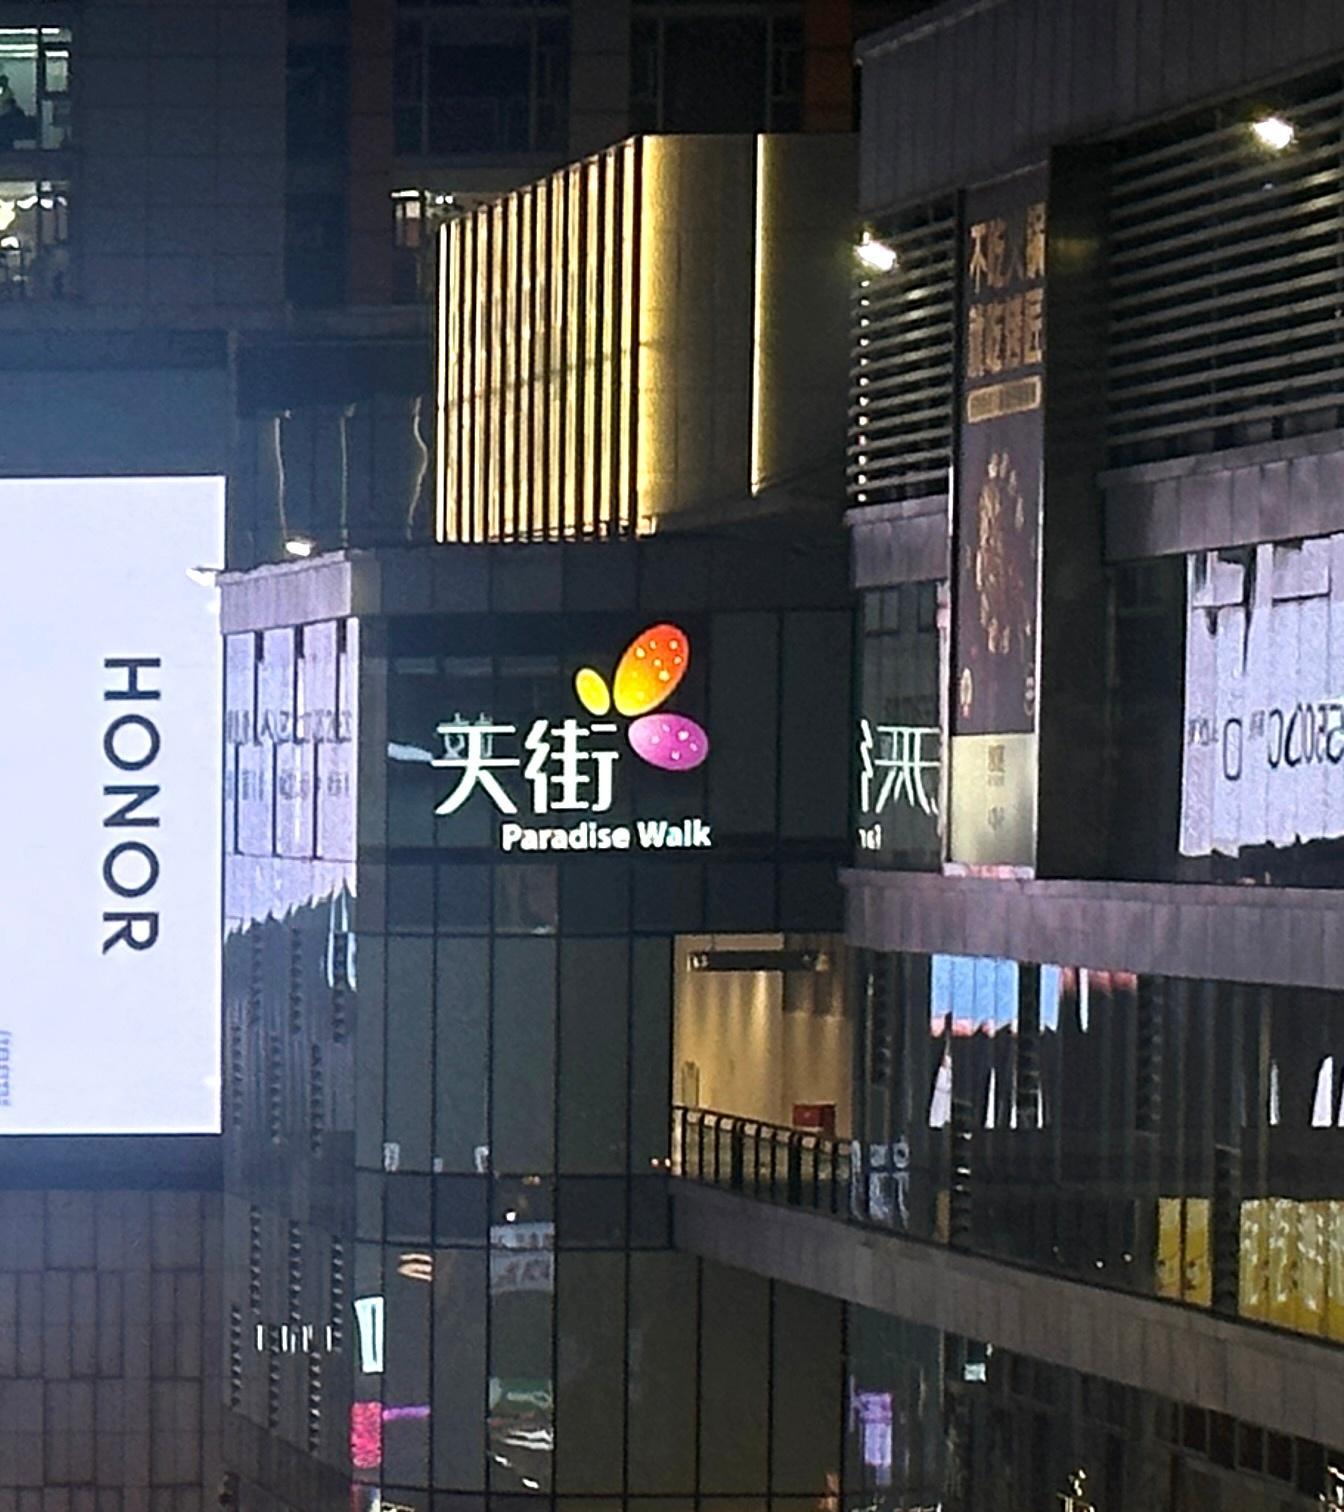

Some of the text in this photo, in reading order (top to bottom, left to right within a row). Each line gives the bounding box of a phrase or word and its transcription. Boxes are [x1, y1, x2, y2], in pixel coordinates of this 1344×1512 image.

[102, 656, 162, 956] HONOR
[431, 719, 619, 815] 天街
[502, 819, 712, 851] Paradise Walk
